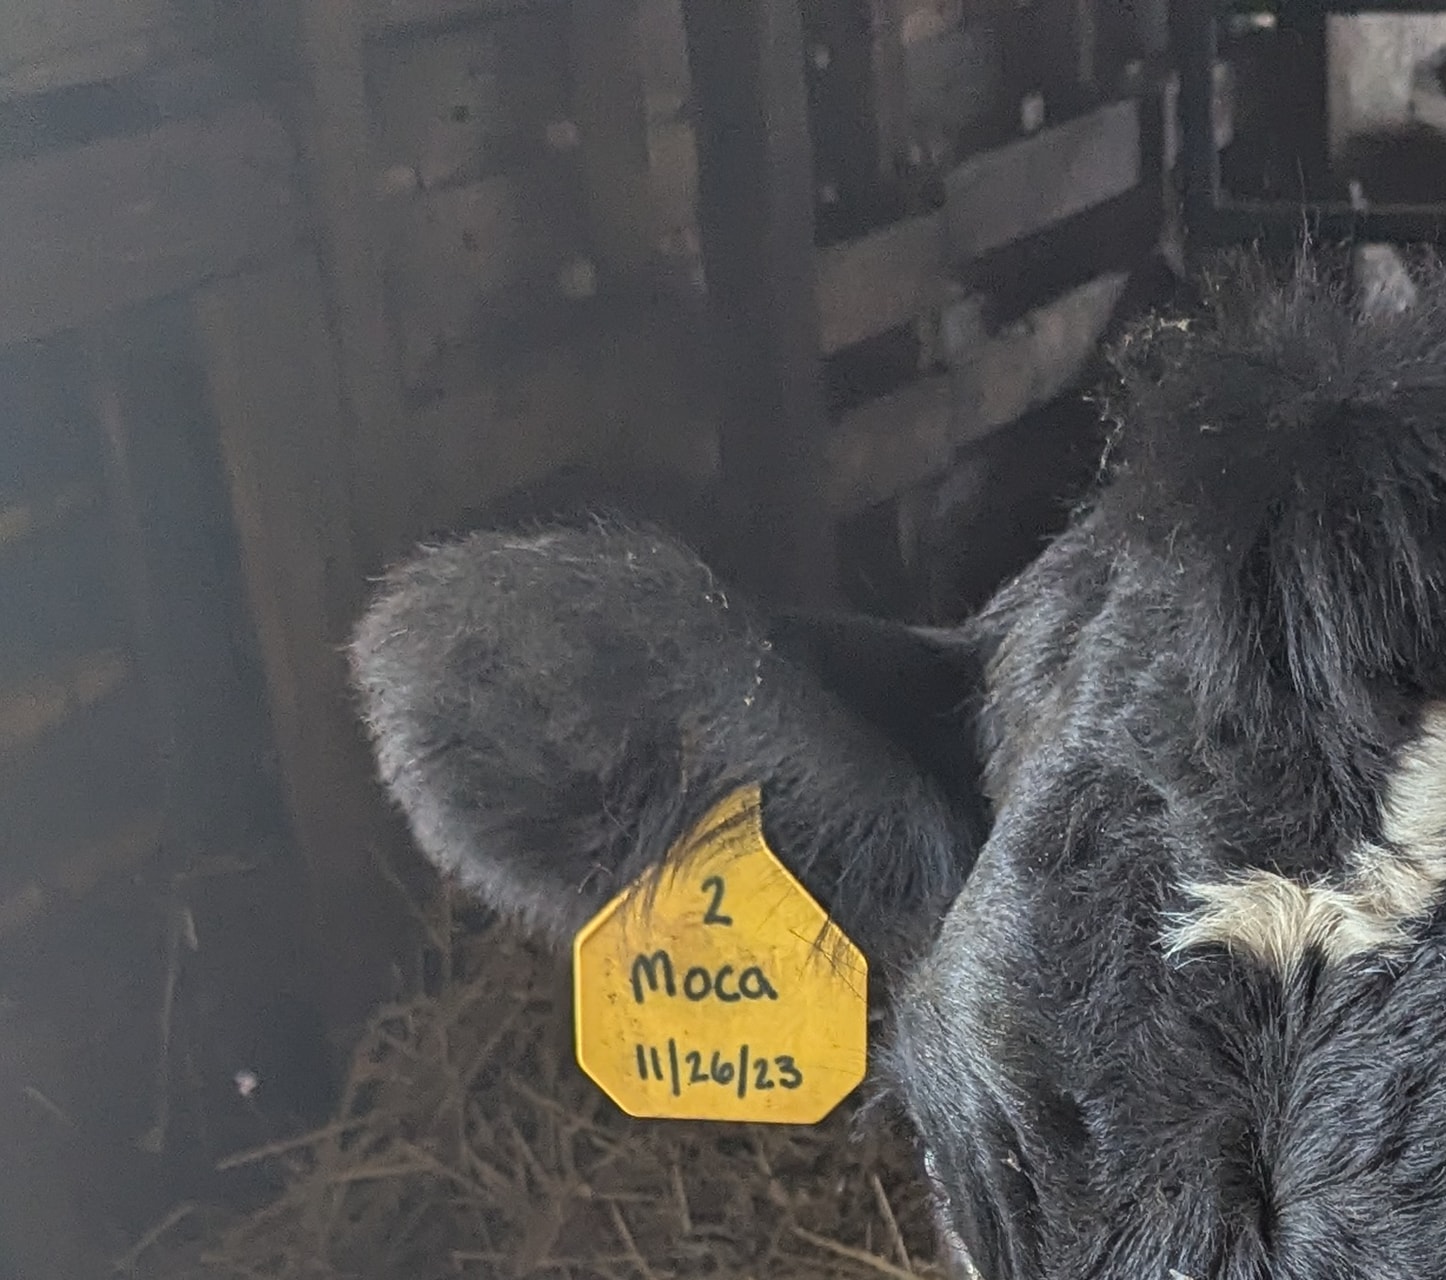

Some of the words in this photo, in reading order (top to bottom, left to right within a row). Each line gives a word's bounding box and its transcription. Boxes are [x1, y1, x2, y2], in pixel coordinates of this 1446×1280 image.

[701, 875, 733, 926] 2
[631, 949, 778, 1004] Moca
[636, 1037, 803, 1098] 11/26/23
